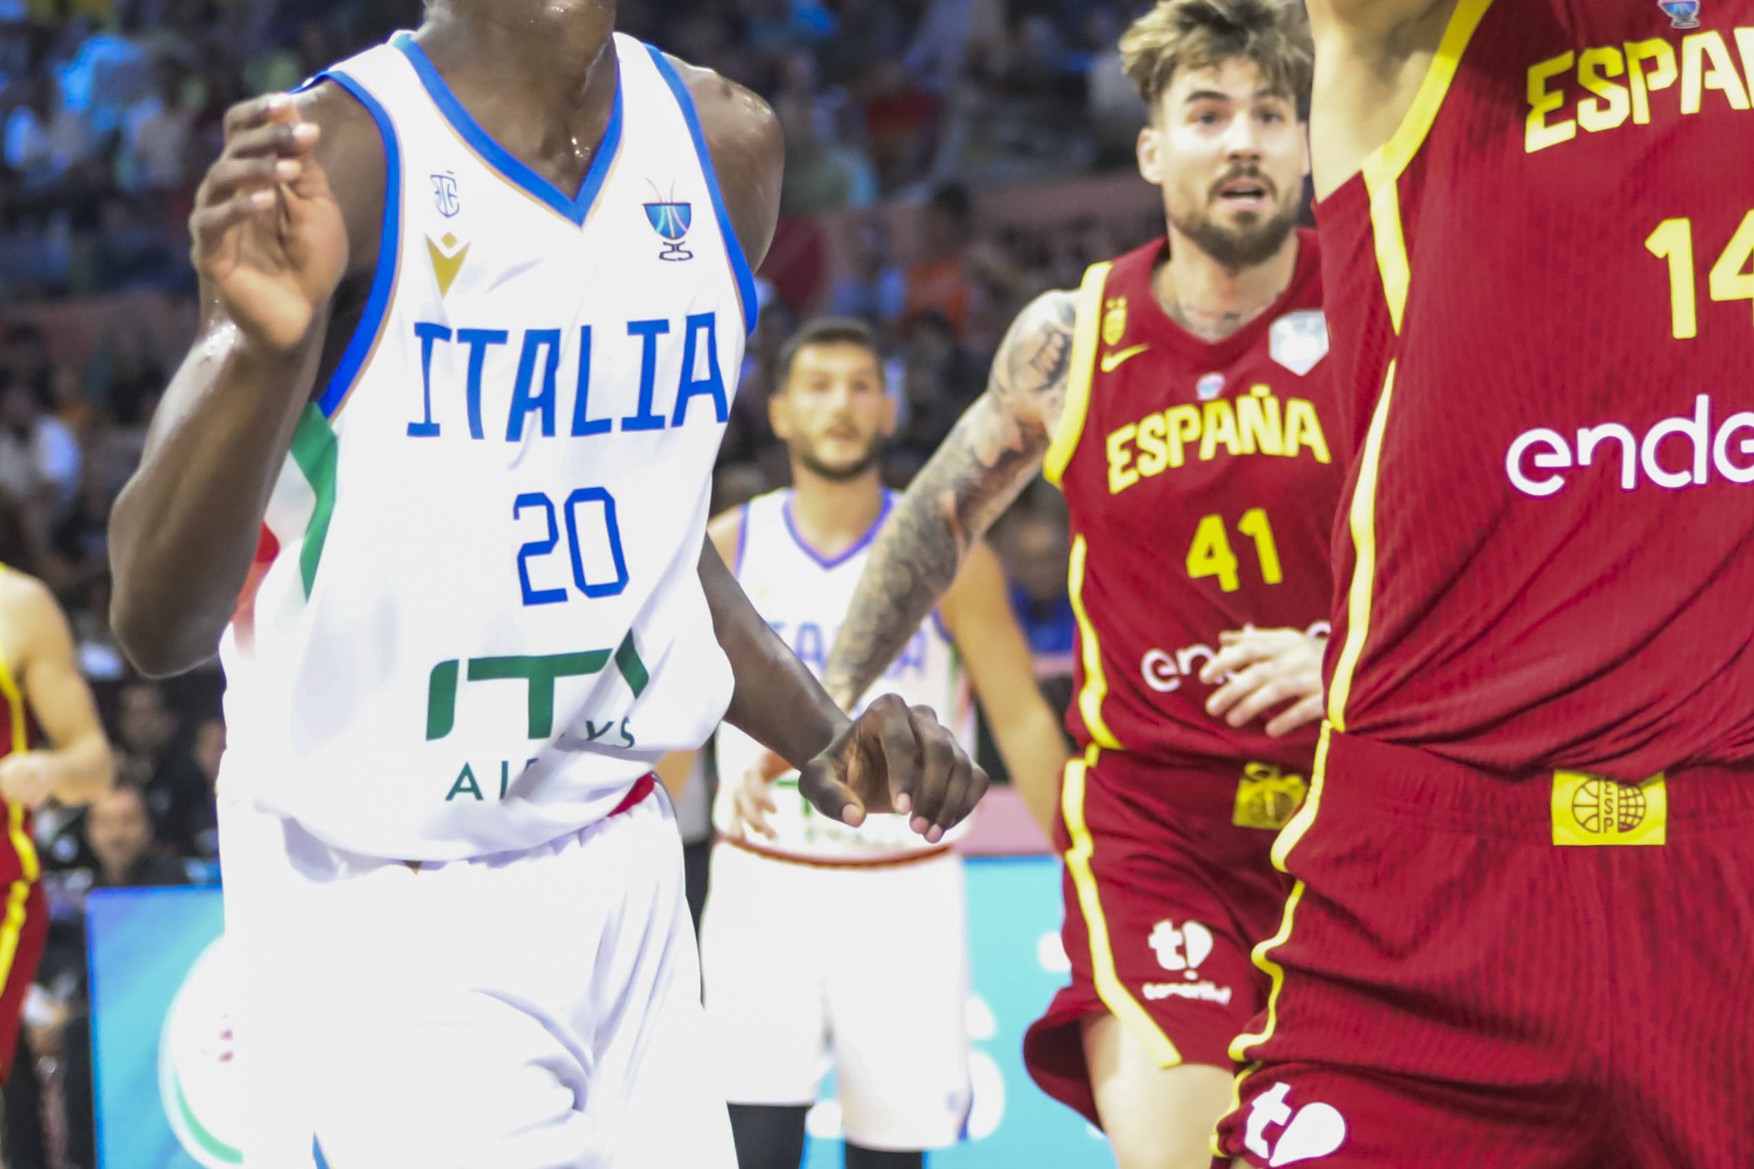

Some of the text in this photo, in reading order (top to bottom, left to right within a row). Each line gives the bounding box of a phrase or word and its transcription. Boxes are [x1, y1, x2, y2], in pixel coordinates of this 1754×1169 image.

[406, 311, 730, 444] ITALIA
[1106, 384, 1331, 494] ESPAÑA
[512, 486, 630, 606] 20
[1185, 508, 1283, 592] 41
